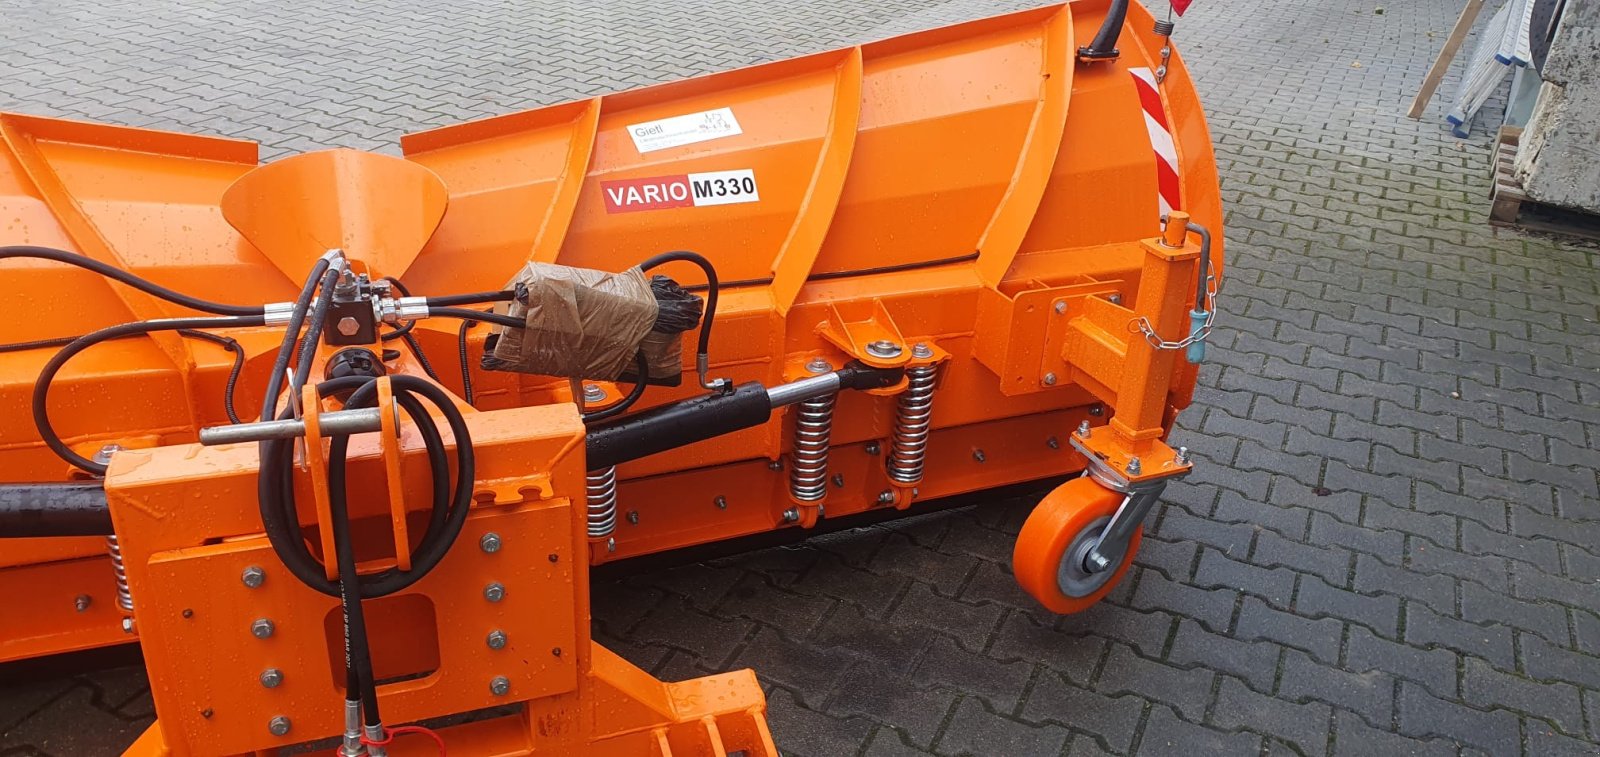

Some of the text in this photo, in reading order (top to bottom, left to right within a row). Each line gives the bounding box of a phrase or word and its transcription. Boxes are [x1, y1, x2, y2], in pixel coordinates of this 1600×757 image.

[635, 124, 664, 137] Gietl
[607, 176, 754, 206] VARIO M330
